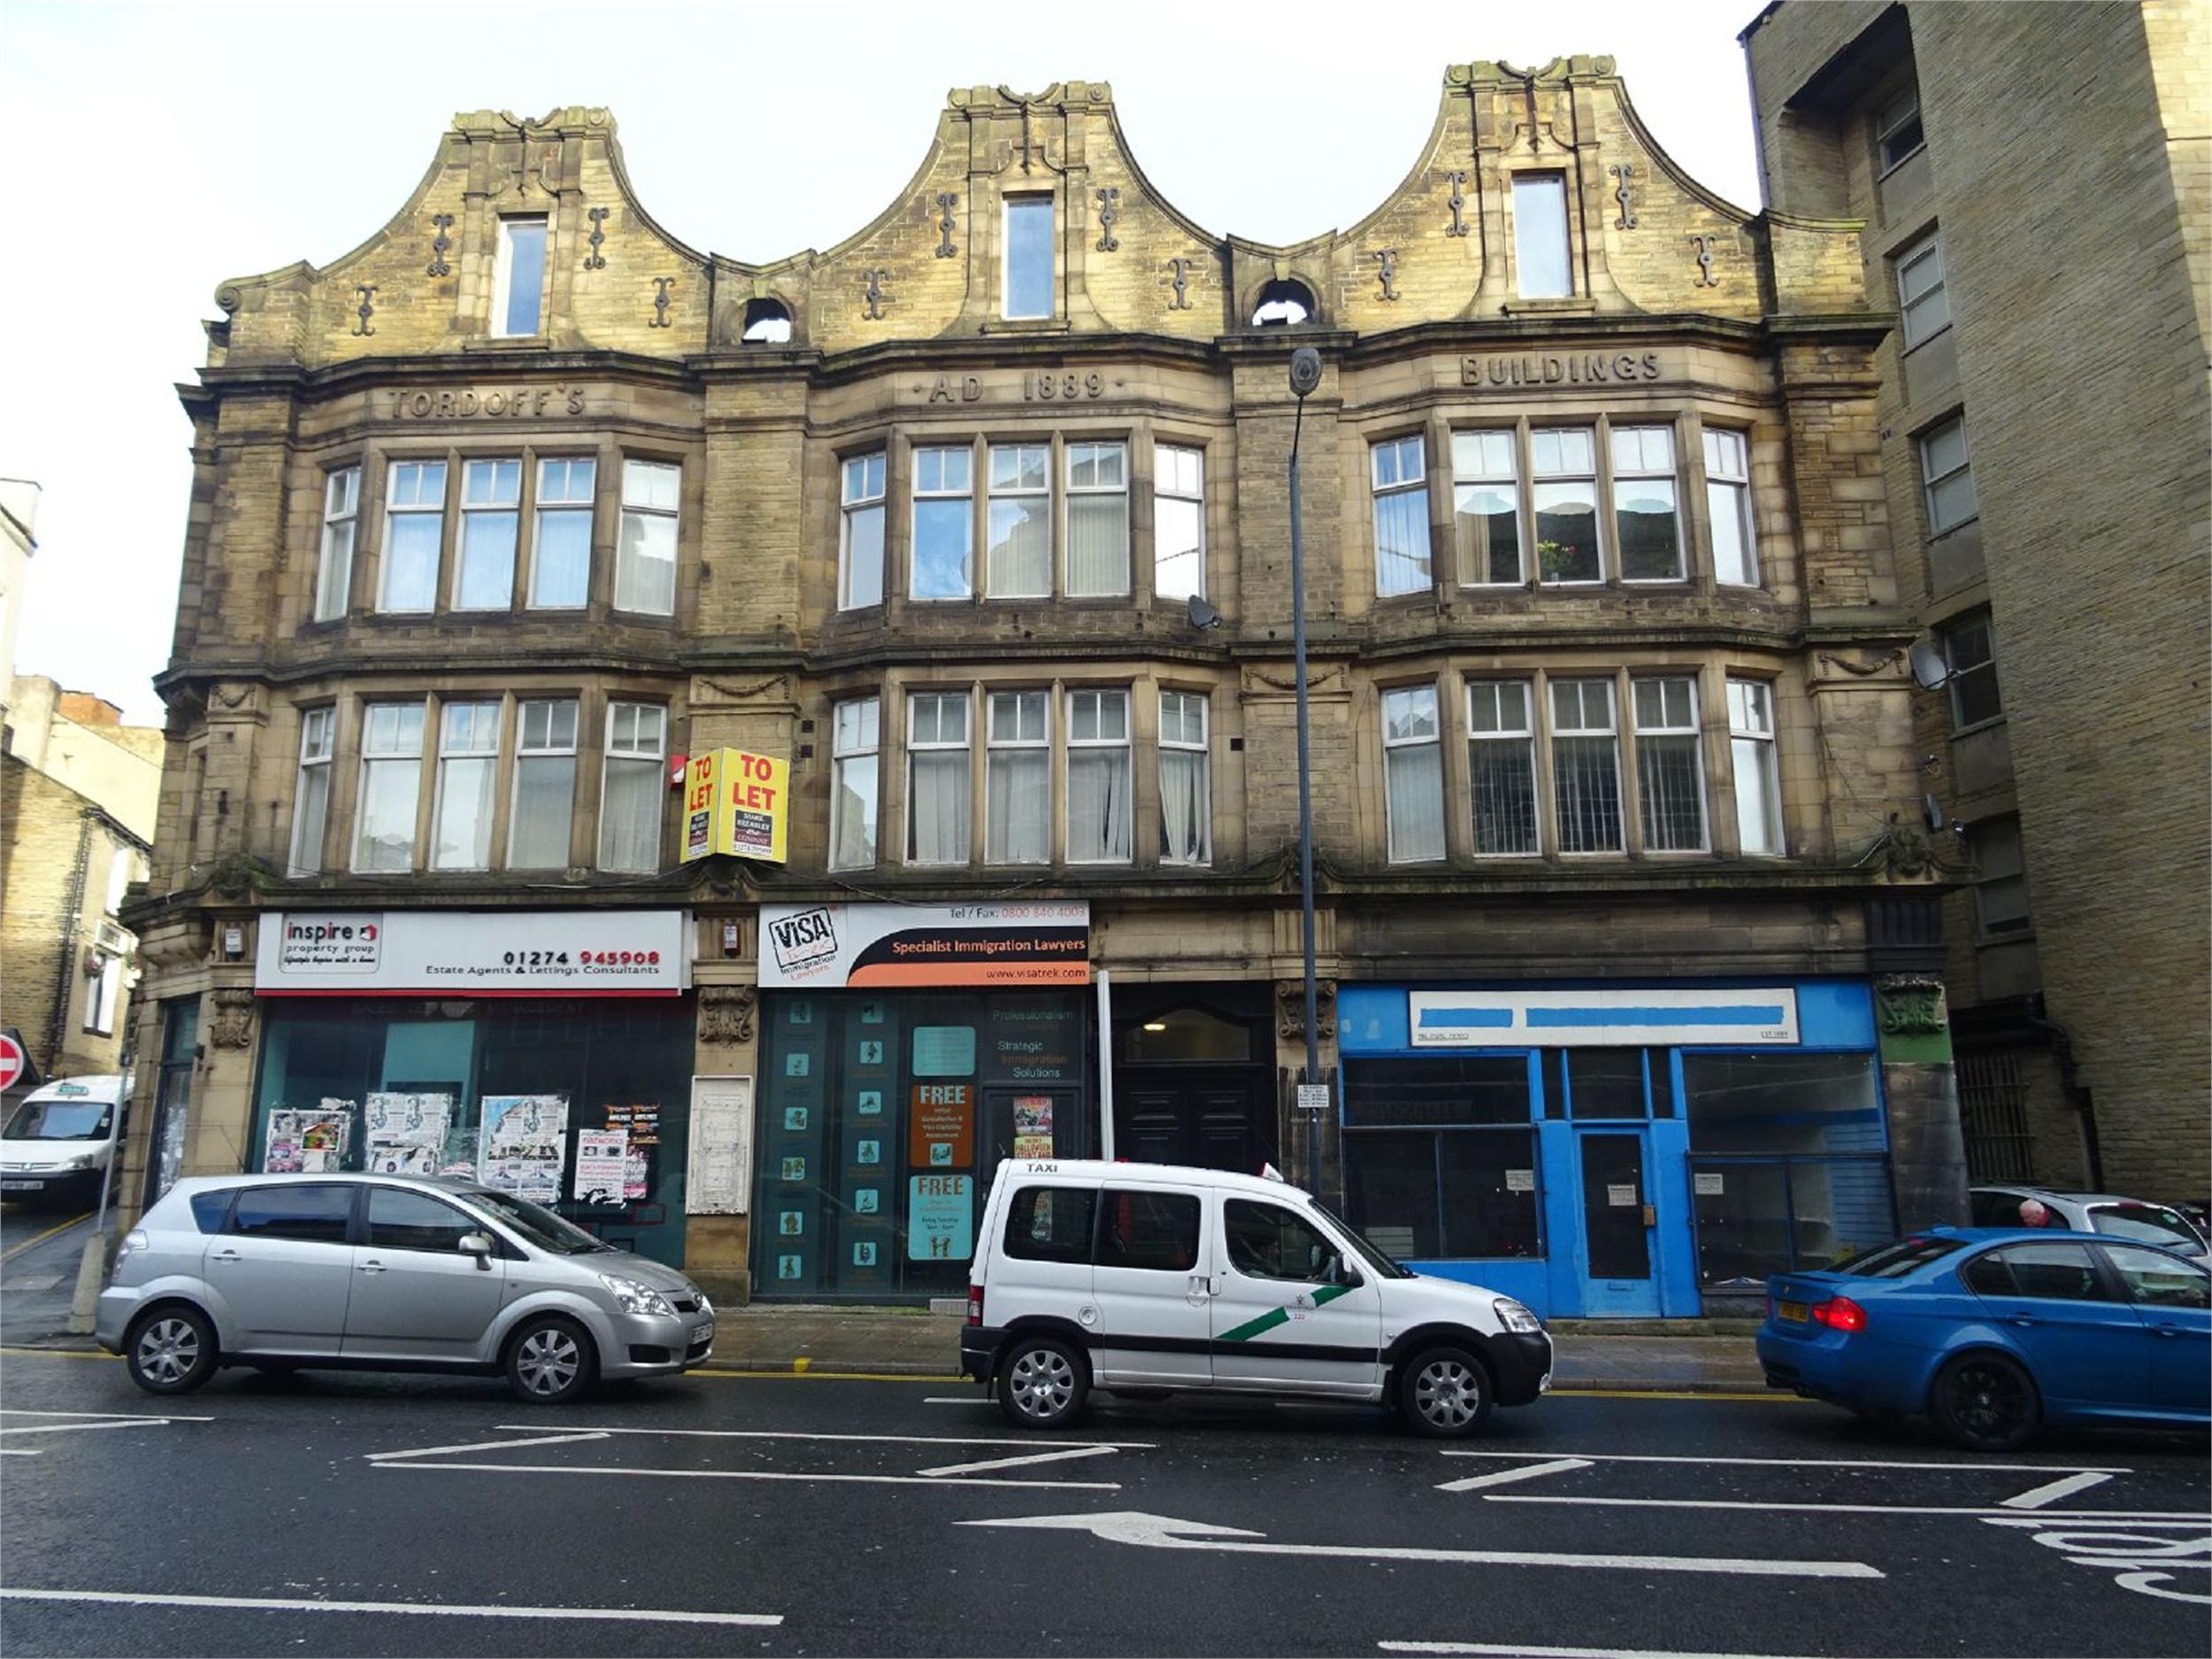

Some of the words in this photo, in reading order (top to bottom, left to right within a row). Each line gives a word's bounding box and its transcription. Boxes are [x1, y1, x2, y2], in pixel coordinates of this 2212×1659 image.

[1460, 352, 1662, 387] BUILDINGS
[928, 373, 985, 403] AD
[1023, 370, 1105, 401] 1889
[388, 381, 586, 419] TORDOFF'S
[695, 755, 712, 782] TO
[740, 754, 773, 782] TO
[688, 782, 713, 812] LET
[733, 781, 777, 811] LET
[951, 907, 965, 918] Tel
[976, 906, 999, 918] Fax:
[1002, 906, 1030, 918] 0800
[287, 921, 354, 944] inspire
[774, 913, 831, 949] VISA
[286, 945, 339, 955] property
[344, 945, 375, 955] group
[503, 951, 569, 965] 01274
[580, 950, 660, 965] 945908
[892, 940, 952, 956] Specialist
[955, 939, 1032, 955] Immigration
[1034, 938, 1087, 953] Lawyers
[426, 965, 465, 975] Estate
[468, 966, 511, 977] Agents
[515, 966, 526, 975] &
[529, 965, 580, 977] Lettings
[583, 964, 660, 975] Consultants
[780, 955, 837, 976] Immigration
[986, 968, 1087, 979] www.visatrek.com
[997, 1040, 1044, 1055] Strategic
[1012, 1065, 1062, 1079] Solutions
[919, 1085, 966, 1105] FREE
[1026, 1163, 1058, 1173] TAXI
[918, 1175, 964, 1196] FREE
